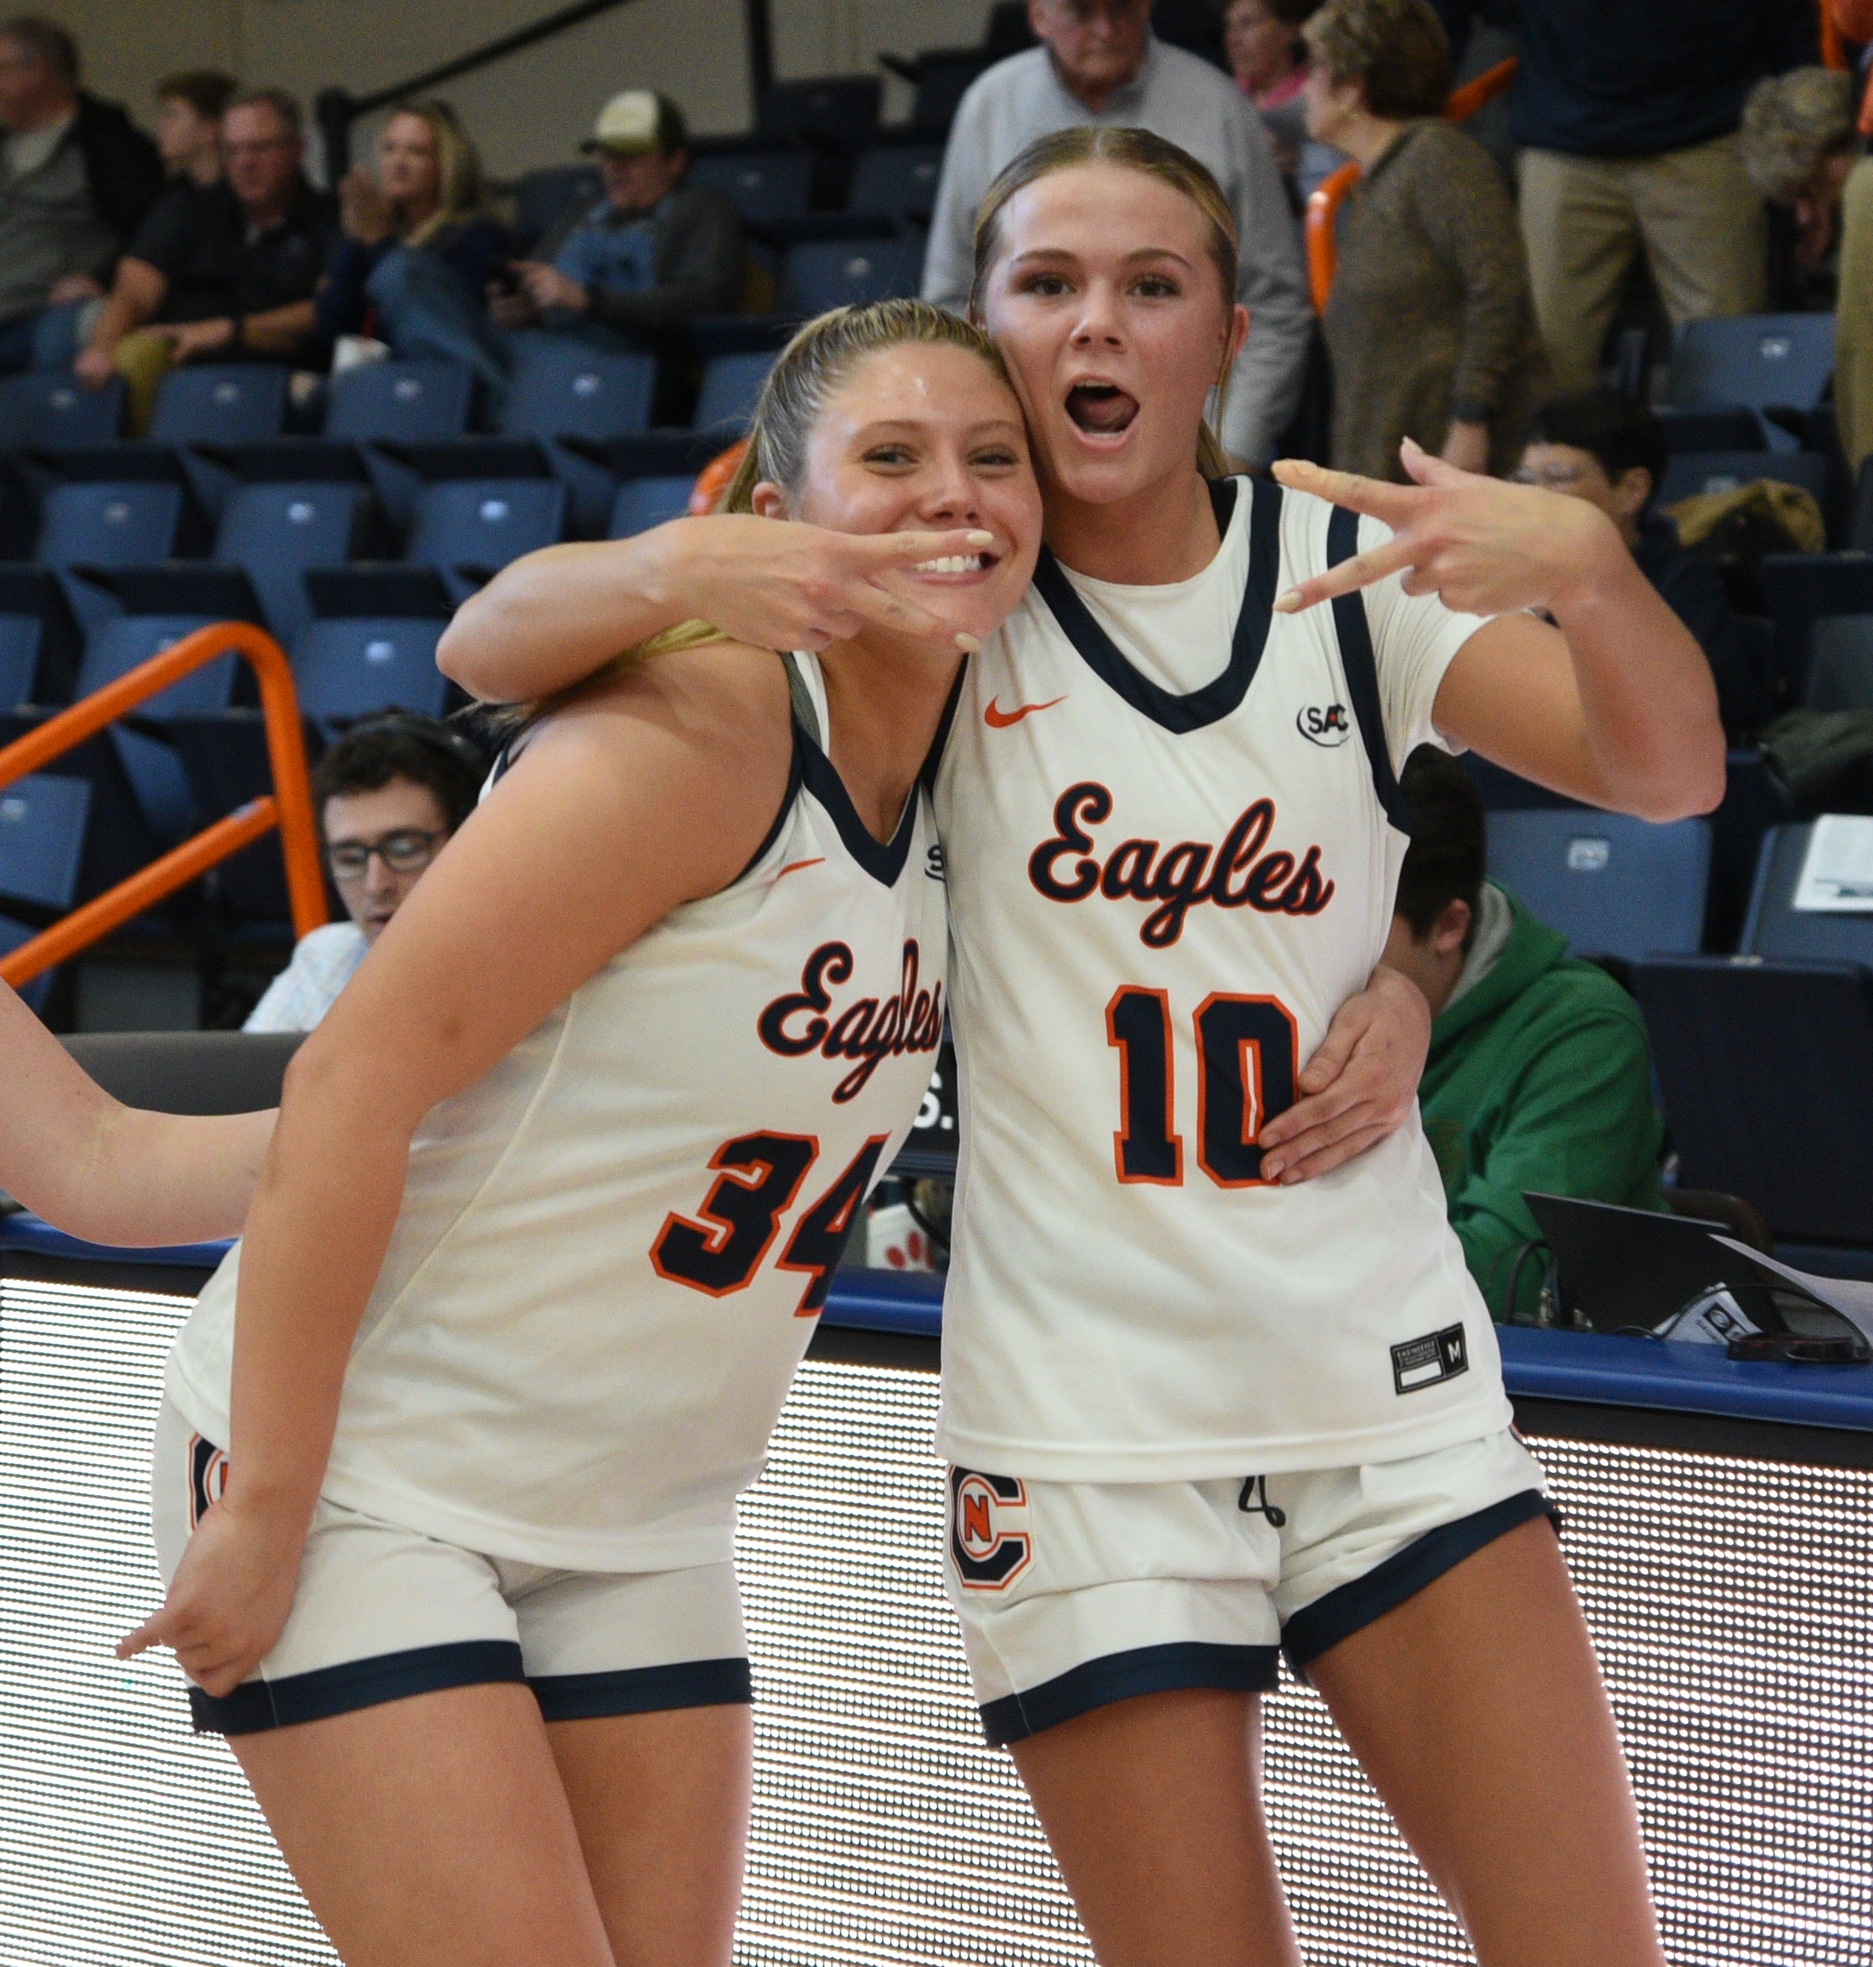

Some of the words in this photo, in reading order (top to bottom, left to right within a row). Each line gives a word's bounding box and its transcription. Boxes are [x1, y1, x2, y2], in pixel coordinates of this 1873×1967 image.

[1307, 703, 1349, 734] SAC
[1028, 780, 1335, 949] Eagles
[757, 937, 942, 1104] Eagles
[1105, 984, 1299, 1189] 10
[649, 1129, 892, 1318] 34
[1446, 1340, 1462, 1364] M
